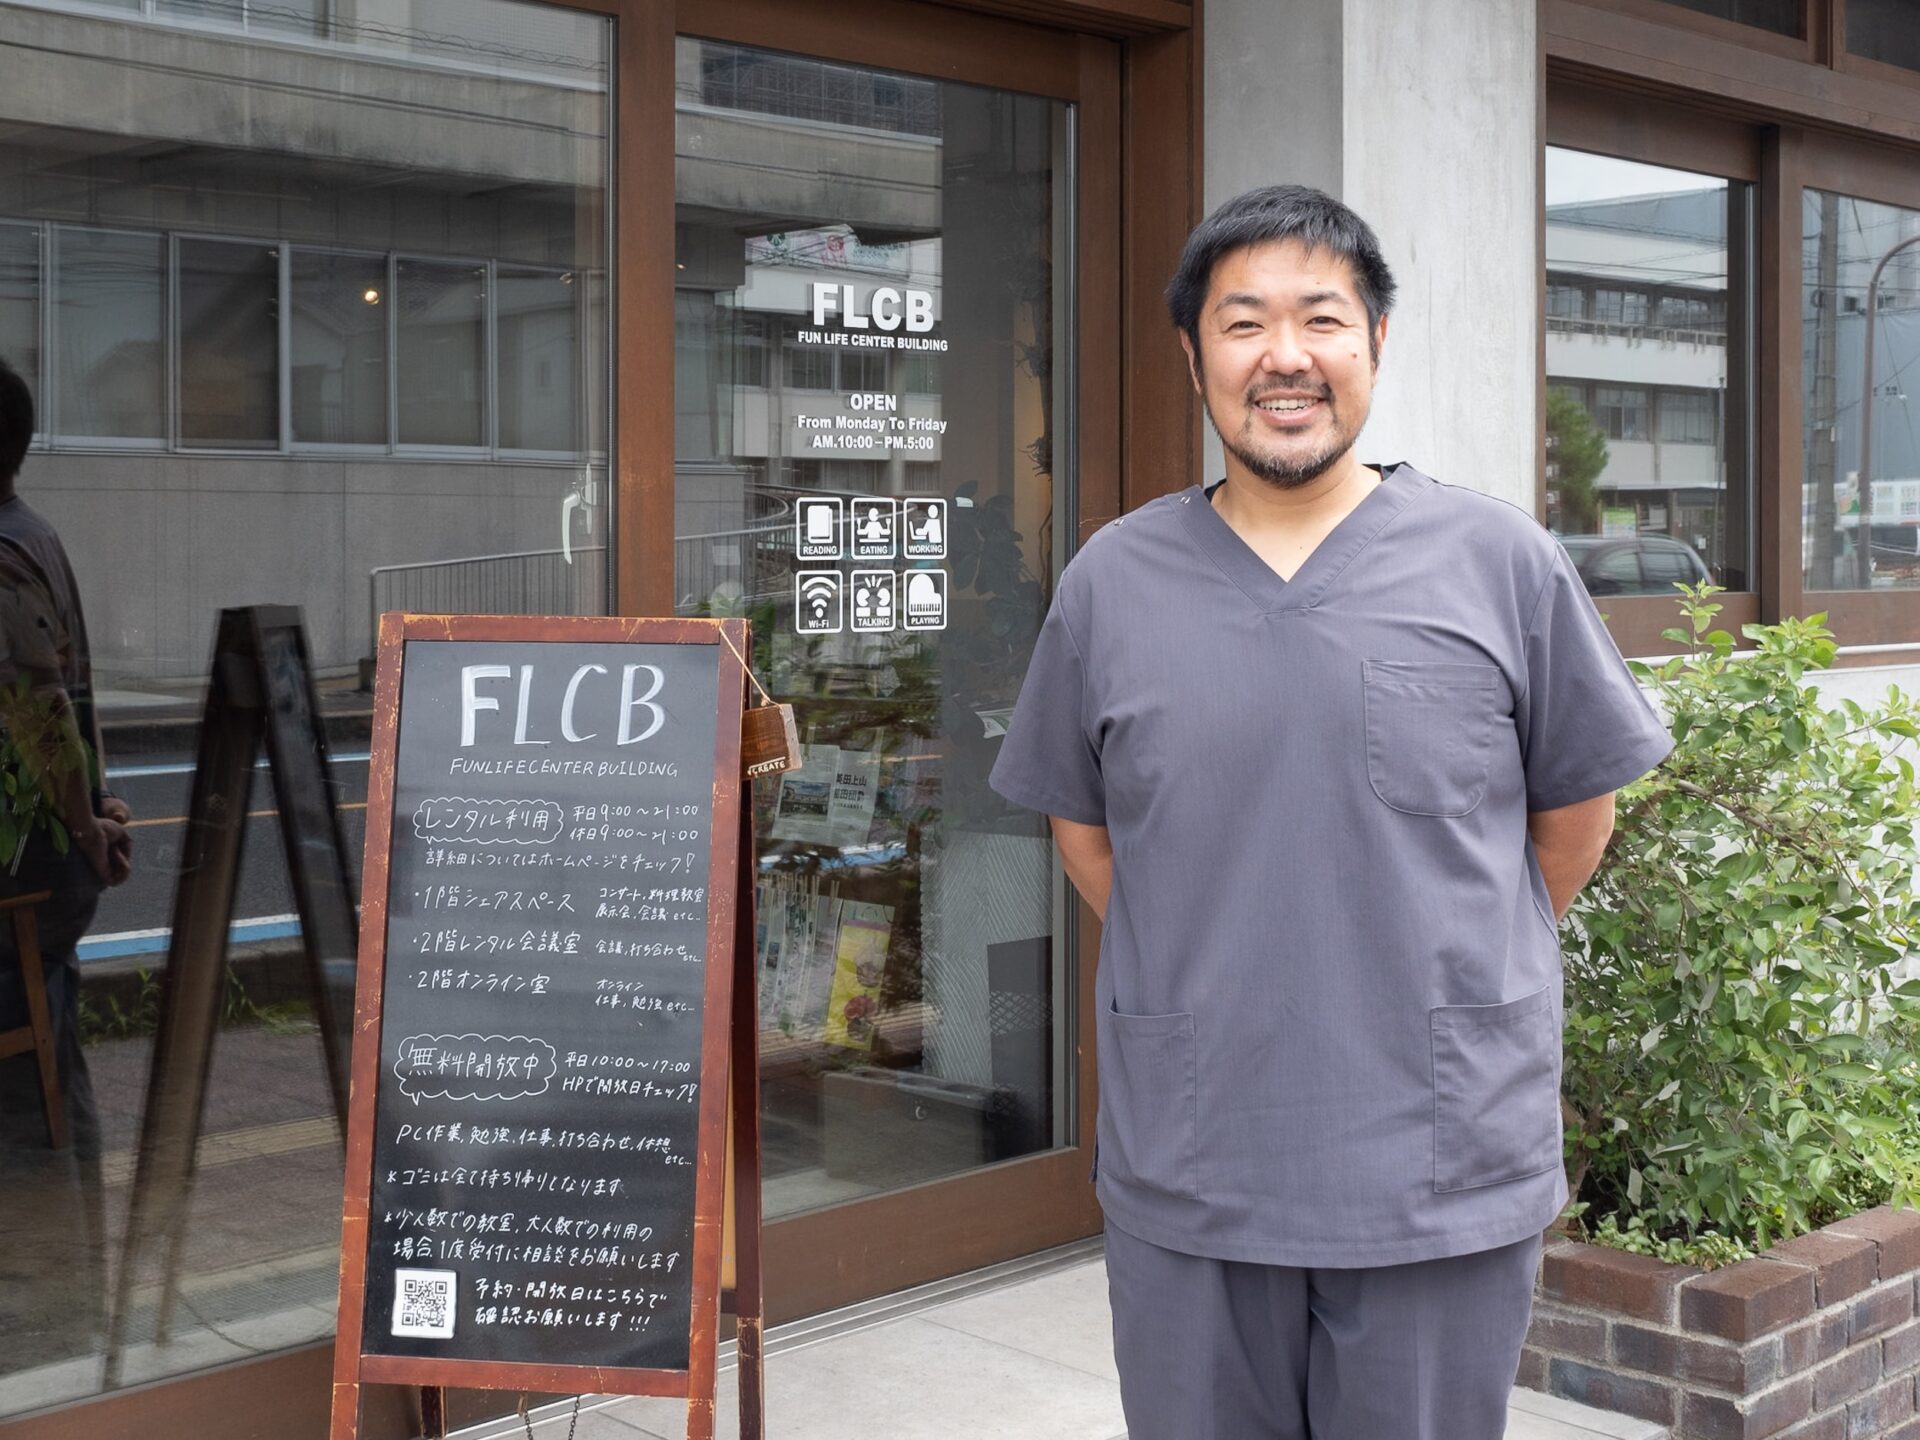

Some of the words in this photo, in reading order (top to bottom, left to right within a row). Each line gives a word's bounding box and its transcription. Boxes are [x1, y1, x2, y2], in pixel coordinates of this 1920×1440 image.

[813, 282, 934, 333] FLCB
[798, 331, 822, 345] FUN
[824, 332, 849, 346] LIFE
[851, 334, 895, 349] CENTER
[897, 336, 948, 351] BUILDING
[850, 393, 897, 411] OPEN
[797, 415, 832, 429] From
[835, 416, 885, 432] Monday
[888, 417, 905, 430] To
[908, 418, 947, 433] Friday
[803, 545, 837, 555] READING
[860, 545, 888, 554] EATING
[908, 544, 942, 554] WORKING
[808, 618, 829, 629] Wi-Fi
[857, 617, 890, 627] TALKING
[911, 616, 939, 626] PLAYING
[460, 664, 665, 747] FLCB
[425, 807, 550, 832] レンタル利用
[596, 978, 645, 991] オンライン
[408, 1043, 539, 1080] 無料開放中
